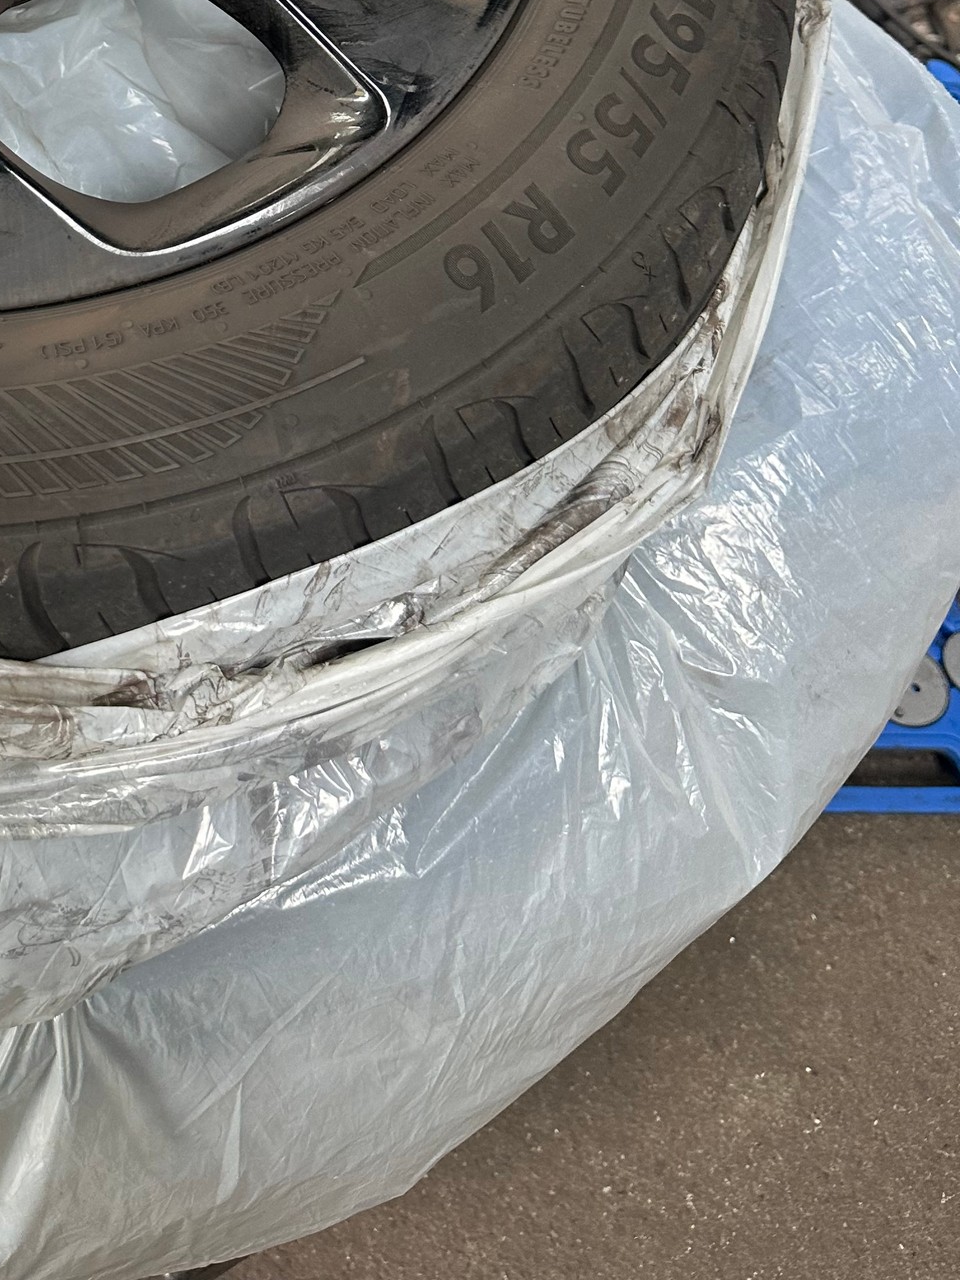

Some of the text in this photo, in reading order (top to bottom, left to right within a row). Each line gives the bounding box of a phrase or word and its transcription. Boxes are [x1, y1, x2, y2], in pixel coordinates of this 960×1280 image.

[429, 144, 461, 178] MAX
[446, 158, 481, 188] MAX
[370, 182, 417, 213] LOAD
[351, 191, 437, 253] INFLATION
[444, 182, 576, 314] R16
[243, 251, 341, 305] PRESSURE
